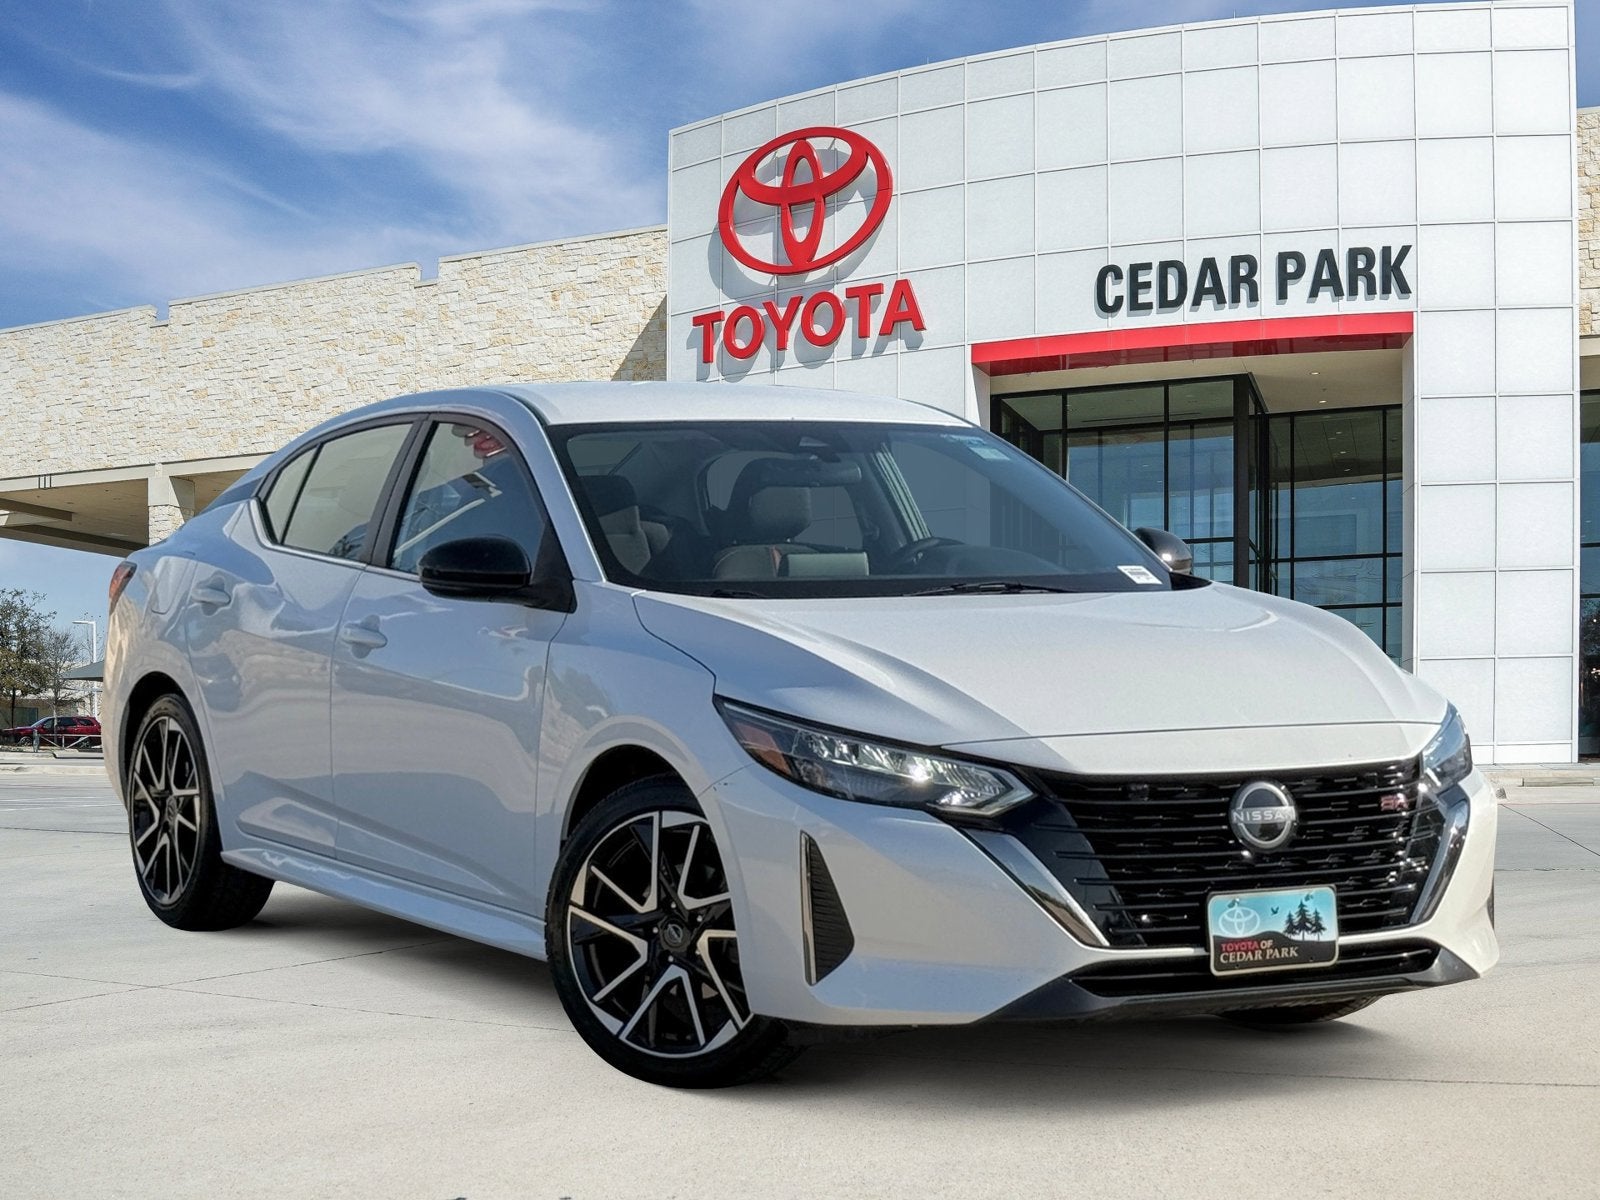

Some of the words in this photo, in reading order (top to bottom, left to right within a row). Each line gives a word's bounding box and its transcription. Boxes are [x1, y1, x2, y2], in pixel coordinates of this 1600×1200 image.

[1097, 252, 1259, 314] CEDAR
[1278, 244, 1412, 306] PARK
[692, 279, 924, 363] TOYOTA
[1232, 809, 1295, 822] NISSAN
[1221, 941, 1259, 952] TOYOTA
[1260, 939, 1273, 949] OF
[1220, 950, 1262, 963] CEDAR
[1266, 946, 1298, 960] PARK
